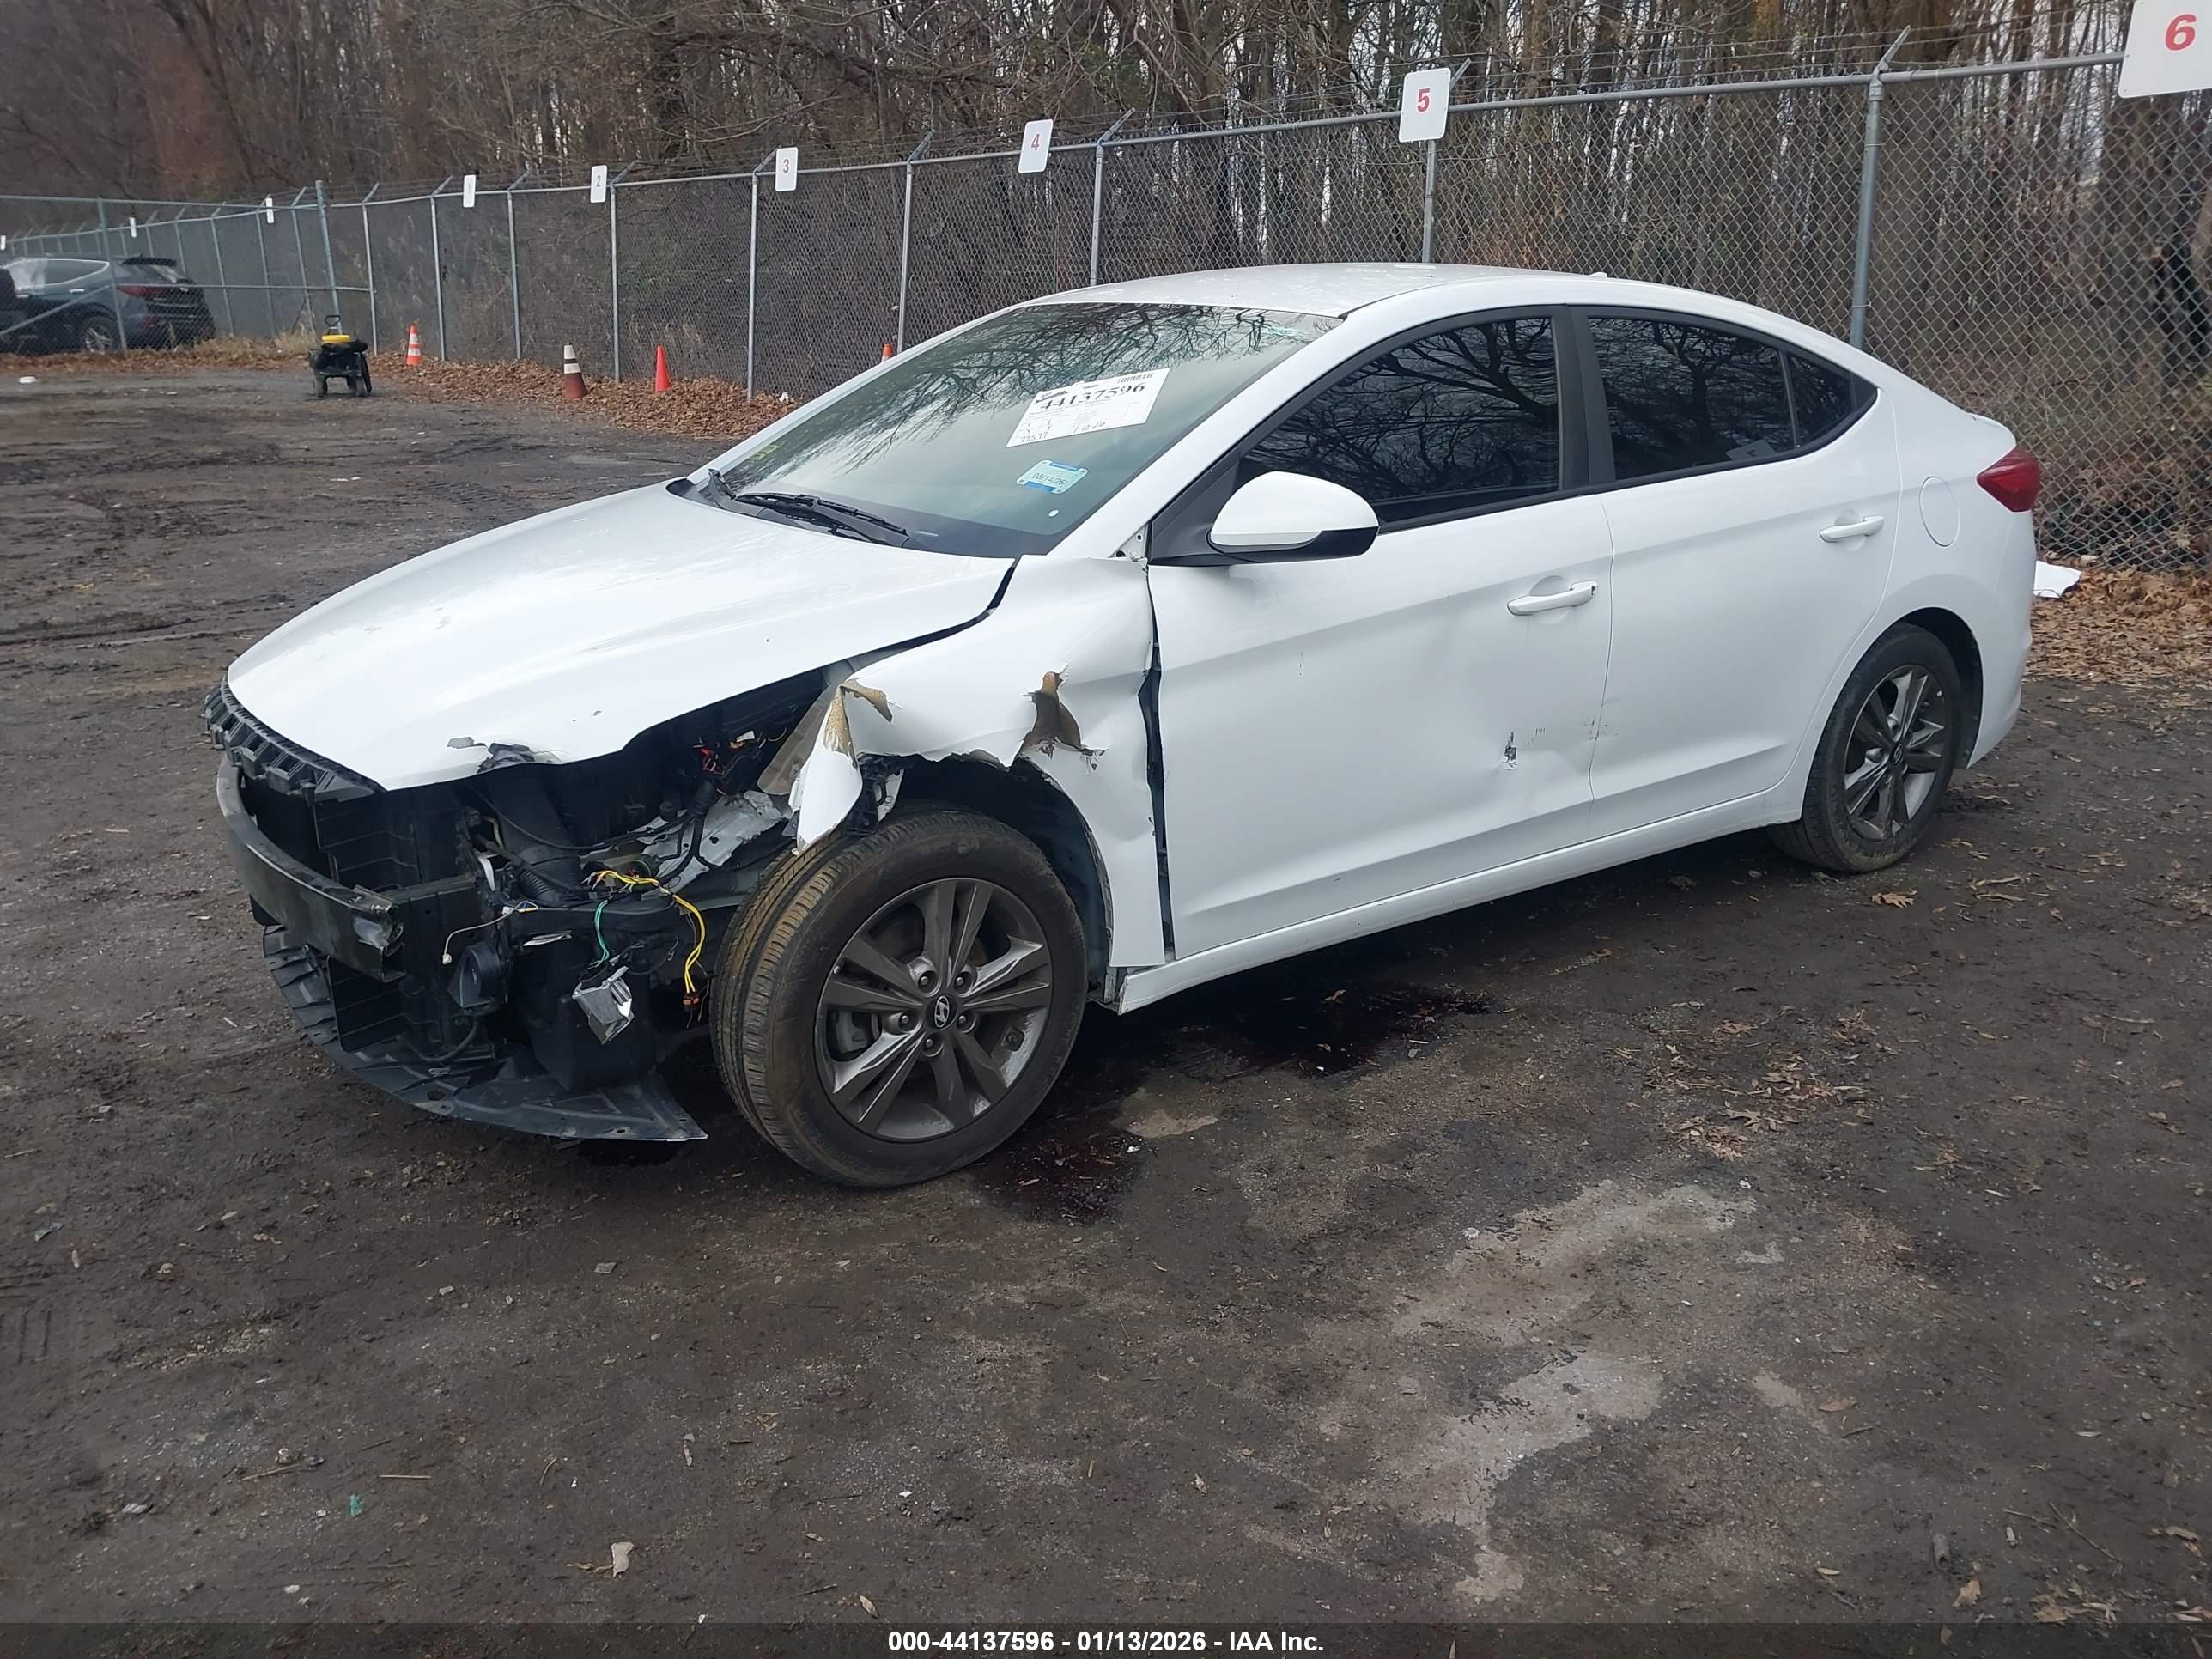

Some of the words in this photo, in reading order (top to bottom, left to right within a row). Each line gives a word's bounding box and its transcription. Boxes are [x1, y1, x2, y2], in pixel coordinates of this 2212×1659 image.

[2164, 13, 2197, 52] 6
[1417, 88, 1431, 112] 5
[1030, 132, 1042, 151] 4
[782, 158, 790, 173] 3
[596, 174, 601, 187] 2
[1040, 382, 1146, 410] 44137596
